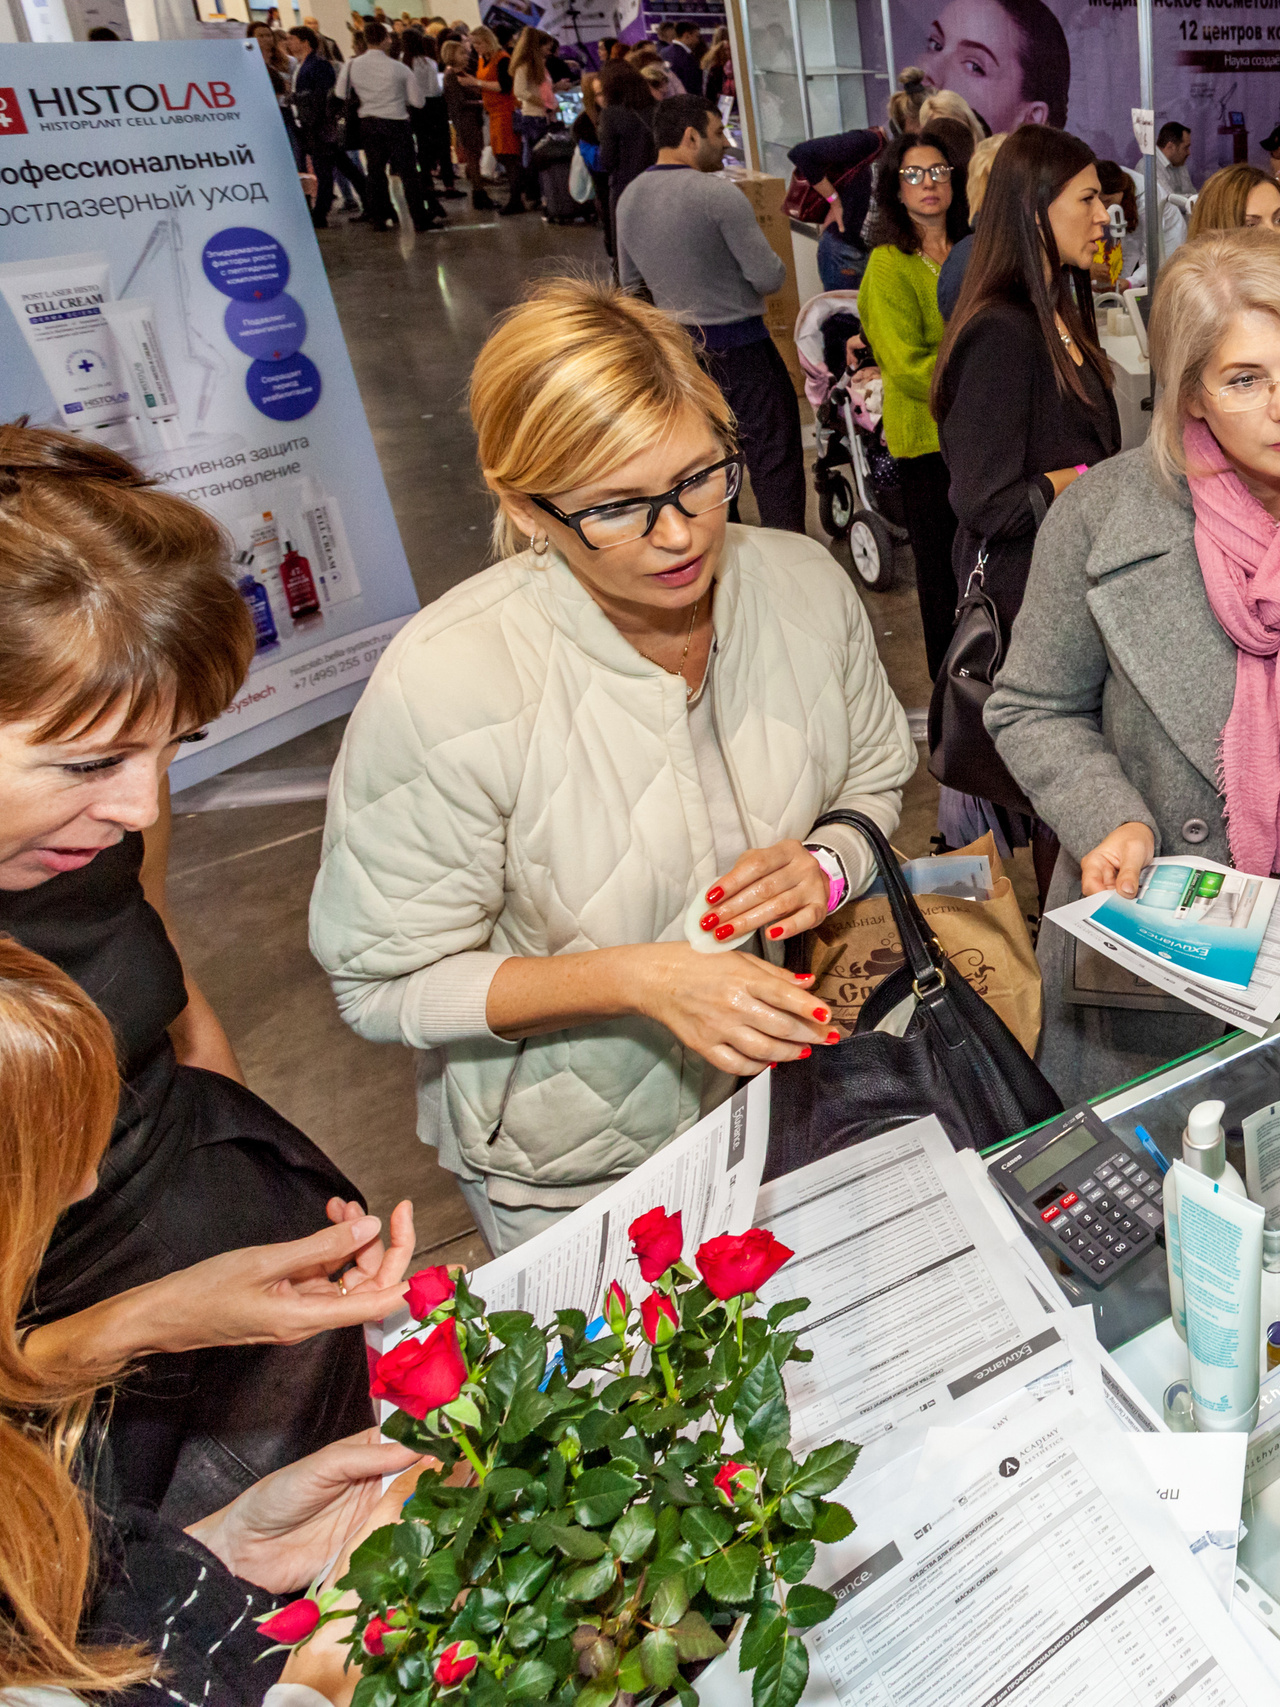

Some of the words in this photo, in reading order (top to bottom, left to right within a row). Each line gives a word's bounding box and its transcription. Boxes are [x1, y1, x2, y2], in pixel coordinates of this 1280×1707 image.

[1179, 20, 1198, 41] 12
[1203, 24, 1262, 44] центров
[1224, 54, 1250, 66] Наука
[27, 81, 236, 118] HISTOLAB
[39, 118, 122, 133] HISTOPLANT
[127, 115, 158, 127] CELL
[160, 111, 241, 126] LABORATORY
[199, 182, 269, 212] уход
[148, 453, 246, 484] ективная
[249, 436, 310, 463] защита
[1137, 927, 1209, 958] Exuviance
[1001, 1154, 1022, 1171] Canon
[973, 1342, 1033, 1383] Exuviance
[1019, 1427, 1060, 1459] ACADEMY
[1024, 1436, 1065, 1466] AESTHETICS
[908, 1558, 938, 1583] СРЕДСТВА
[936, 1548, 949, 1561] ДЛЯ
[947, 1536, 966, 1552] КОЖИ
[964, 1520, 985, 1539] ВОКРУГ
[983, 1510, 998, 1523] ГЛАЗ
[975, 1566, 999, 1587] СКРАБЫ
[1006, 1634, 1071, 1692] ПРОФЕССИОНАЛЬНОГО
[1068, 1618, 1089, 1637] УХОДА
